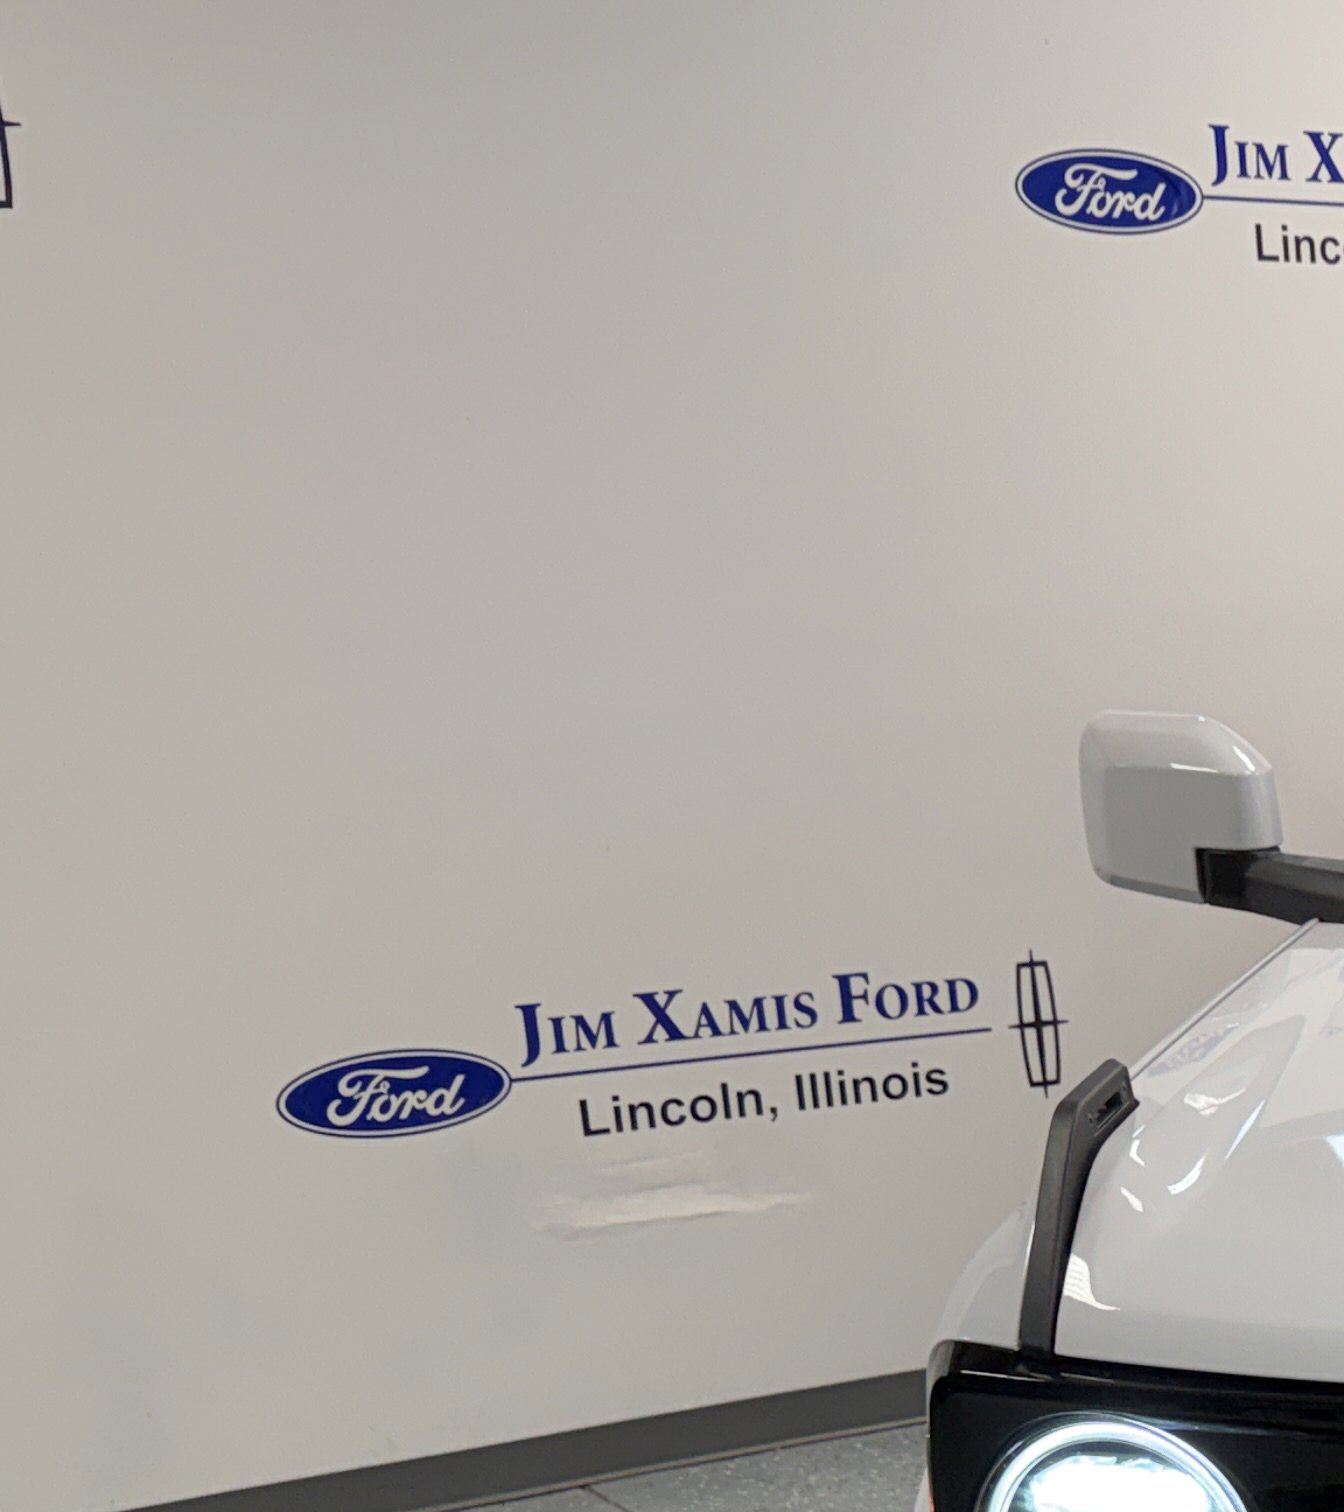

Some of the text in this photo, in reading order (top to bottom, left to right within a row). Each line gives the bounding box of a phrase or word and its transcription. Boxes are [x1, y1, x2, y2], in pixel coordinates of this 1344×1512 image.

[1208, 124, 1289, 187] JIM
[1055, 162, 1164, 222] Ford
[514, 972, 980, 1068] JIM XAMIS FORD
[326, 1066, 465, 1126] Ford
[580, 1060, 950, 1137] Lincoln, Illinois
